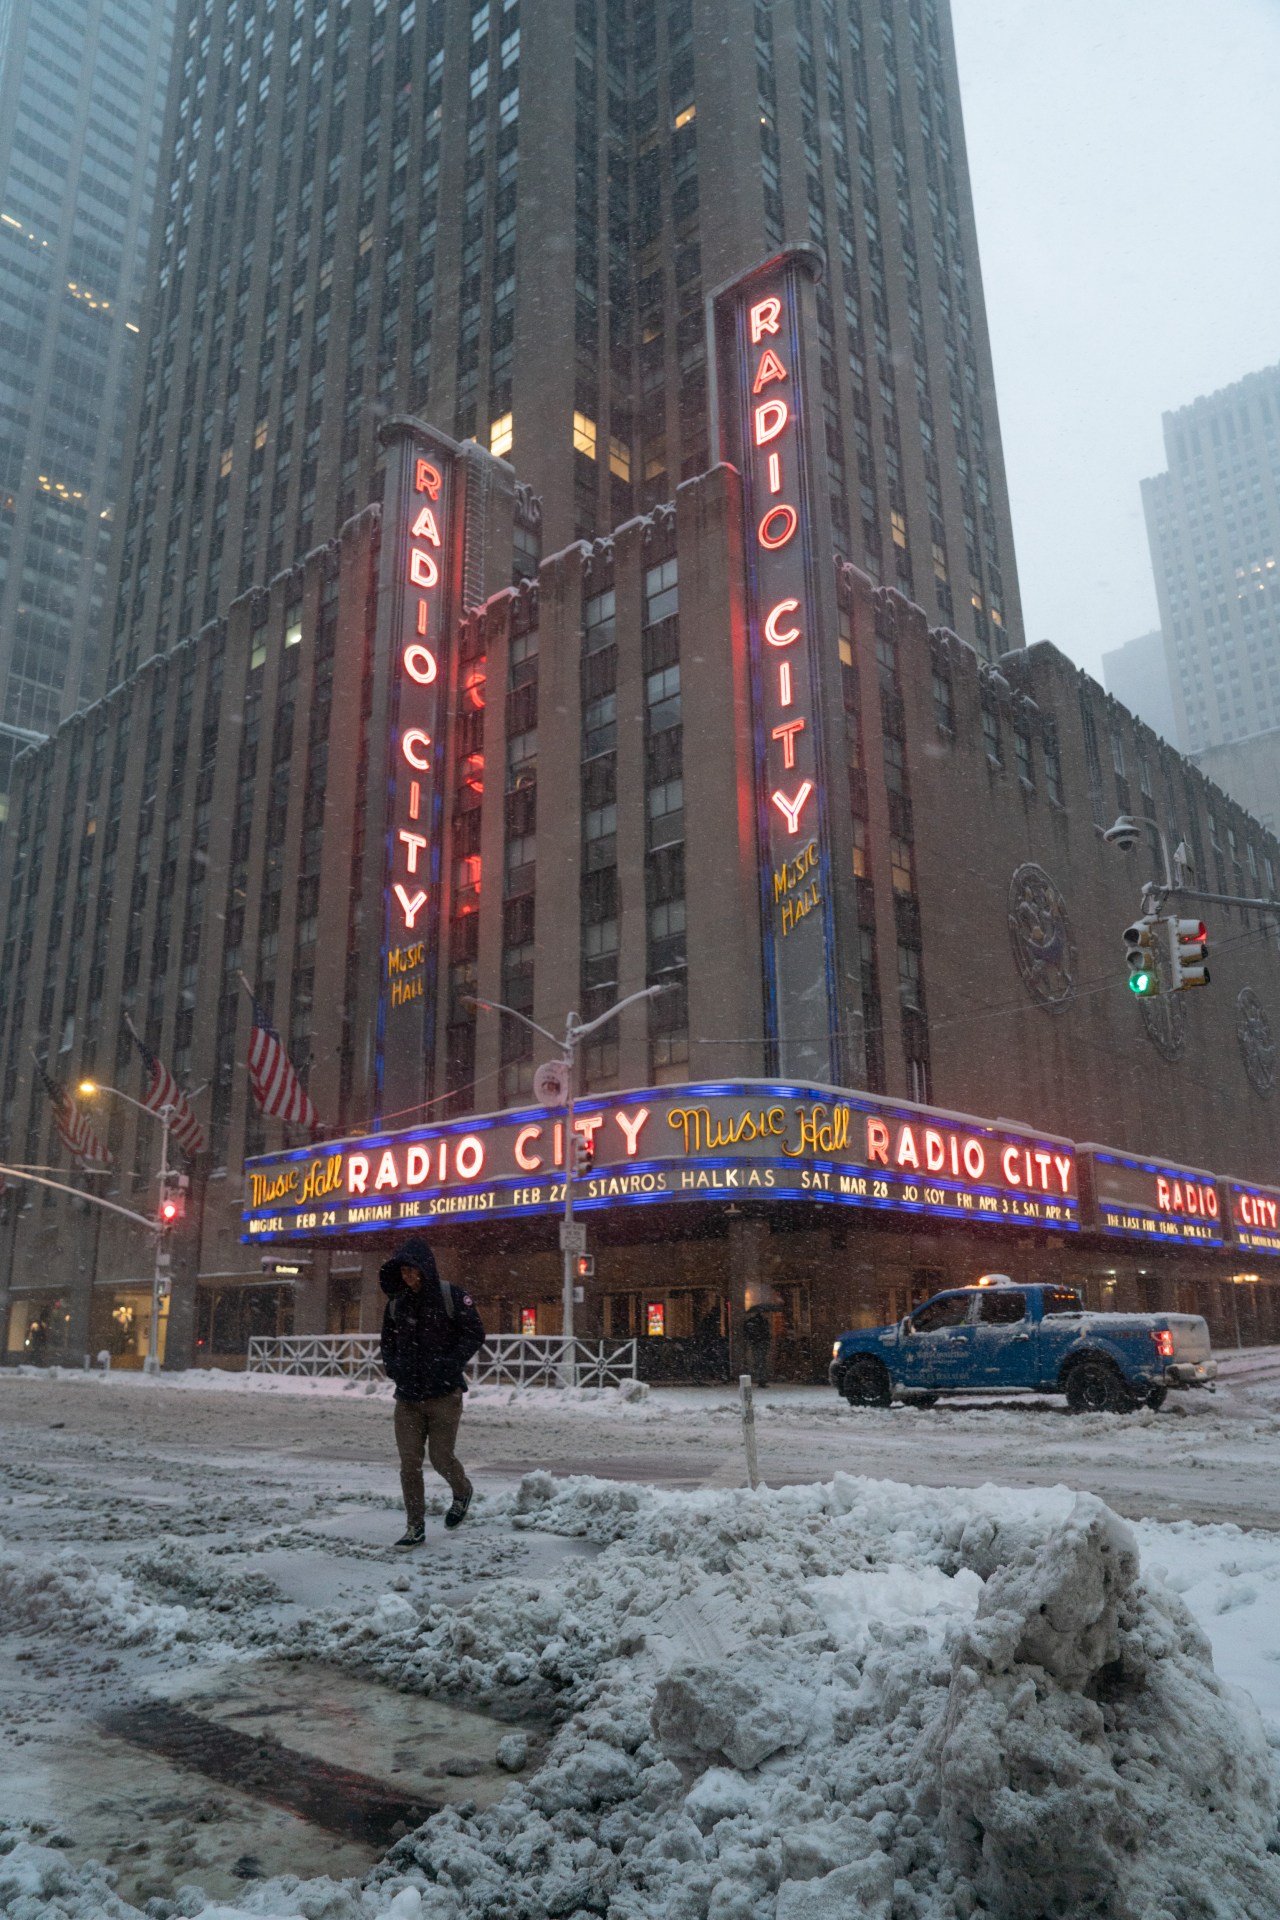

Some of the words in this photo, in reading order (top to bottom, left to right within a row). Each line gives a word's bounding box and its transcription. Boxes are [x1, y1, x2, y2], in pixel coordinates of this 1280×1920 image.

[751, 297, 798, 549] RADIO
[404, 458, 442, 684] RADIO
[765, 599, 812, 834] CITY
[394, 730, 430, 928] CITY
[295, 1154, 342, 1204] Hall
[348, 1135, 484, 1193] RADIO
[514, 1107, 648, 1171] CITY
[667, 1108, 787, 1153] Music
[782, 1106, 849, 1157] Hall
[867, 1118, 985, 1179] RADIO
[1003, 1147, 1071, 1193] CITY
[250, 1217, 284, 1233] MIGUEL
[296, 1211, 316, 1228] FEB
[322, 1211, 336, 1225] 24
[348, 1205, 392, 1223] MARIAH
[400, 1201, 420, 1217] THE
[429, 1192, 495, 1214] SCIENTIST
[514, 1188, 541, 1206] FEB
[550, 1184, 568, 1202] 27
[589, 1173, 667, 1197] STAVROS
[682, 1169, 775, 1188] HALKIAS
[840, 1176, 867, 1195] MAR
[873, 1180, 888, 1198] 28
[902, 1185, 918, 1201] JO
[924, 1188, 945, 1205] KOY
[979, 1195, 998, 1212] APR
[1002, 1198, 1009, 1213] 3
[1045, 1205, 1061, 1220] APR
[1064, 1207, 1071, 1220] 4
[1107, 1213, 1119, 1227] THE
[1122, 1216, 1140, 1230] LAST
[1157, 1177, 1218, 1217] RADIO
[1240, 1194, 1276, 1228] CITY
